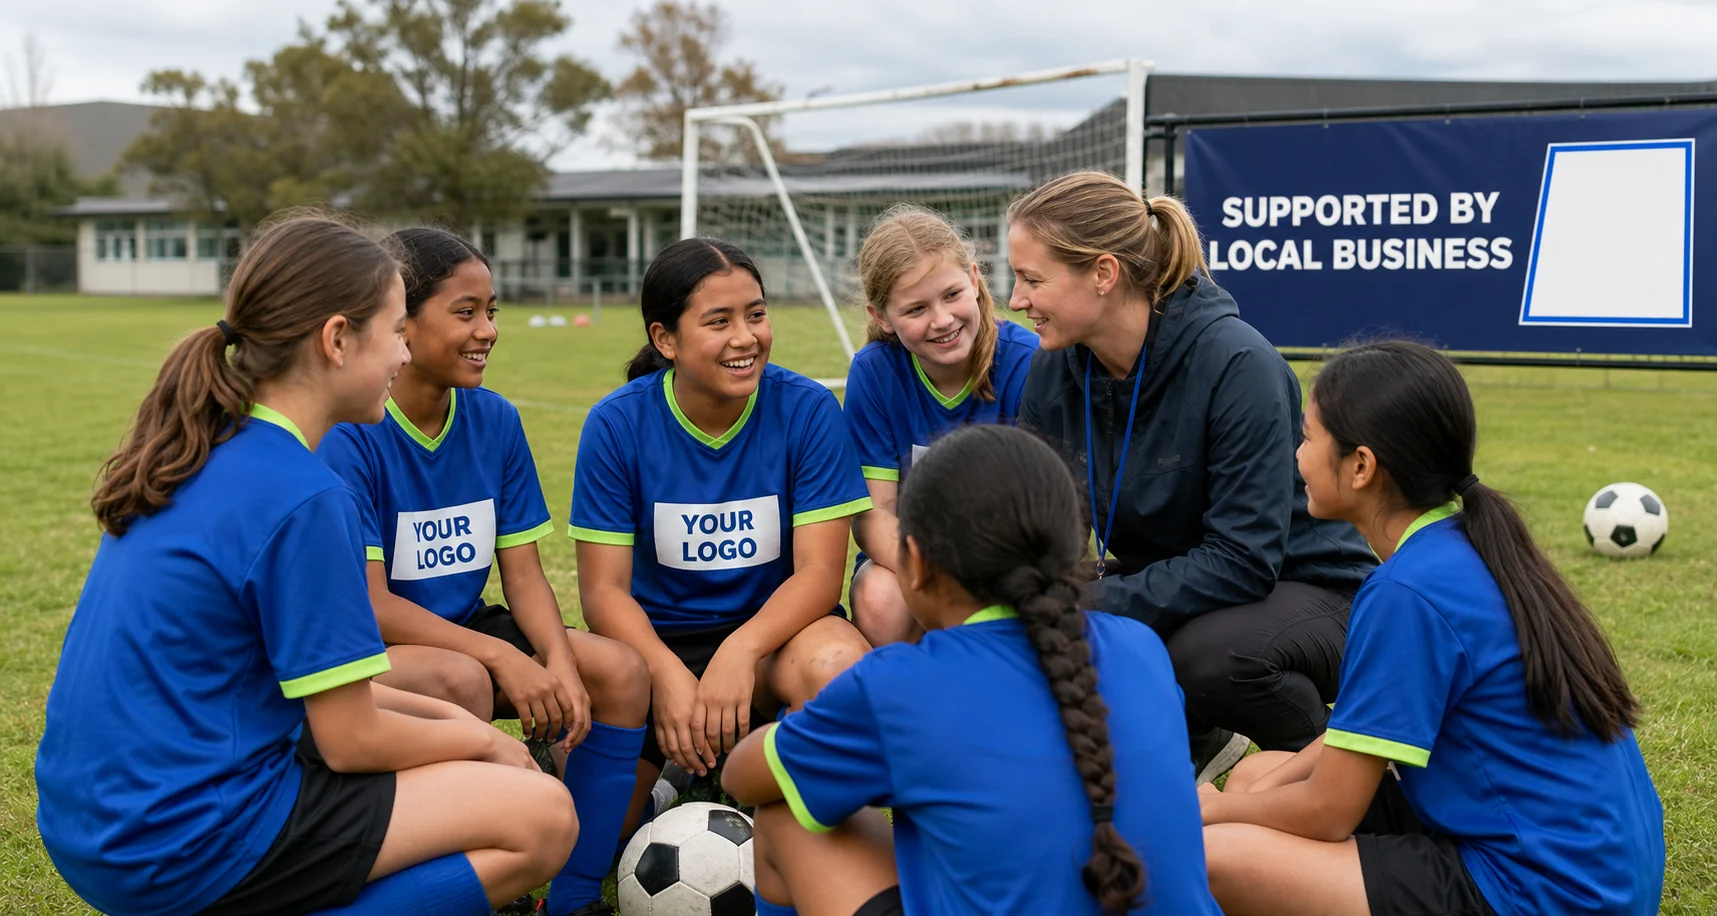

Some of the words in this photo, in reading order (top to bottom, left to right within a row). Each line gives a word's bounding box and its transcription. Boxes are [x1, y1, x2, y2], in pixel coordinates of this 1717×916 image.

[1221, 193, 1439, 228] SUPPORTED
[1450, 191, 1500, 224] BY
[1209, 239, 1323, 271] LOCAL
[1332, 236, 1513, 270] BUSINESS
[412, 515, 473, 543] YOUR
[680, 509, 755, 535] YOUR
[416, 542, 476, 570] LOGO
[682, 537, 758, 562] LOGO
